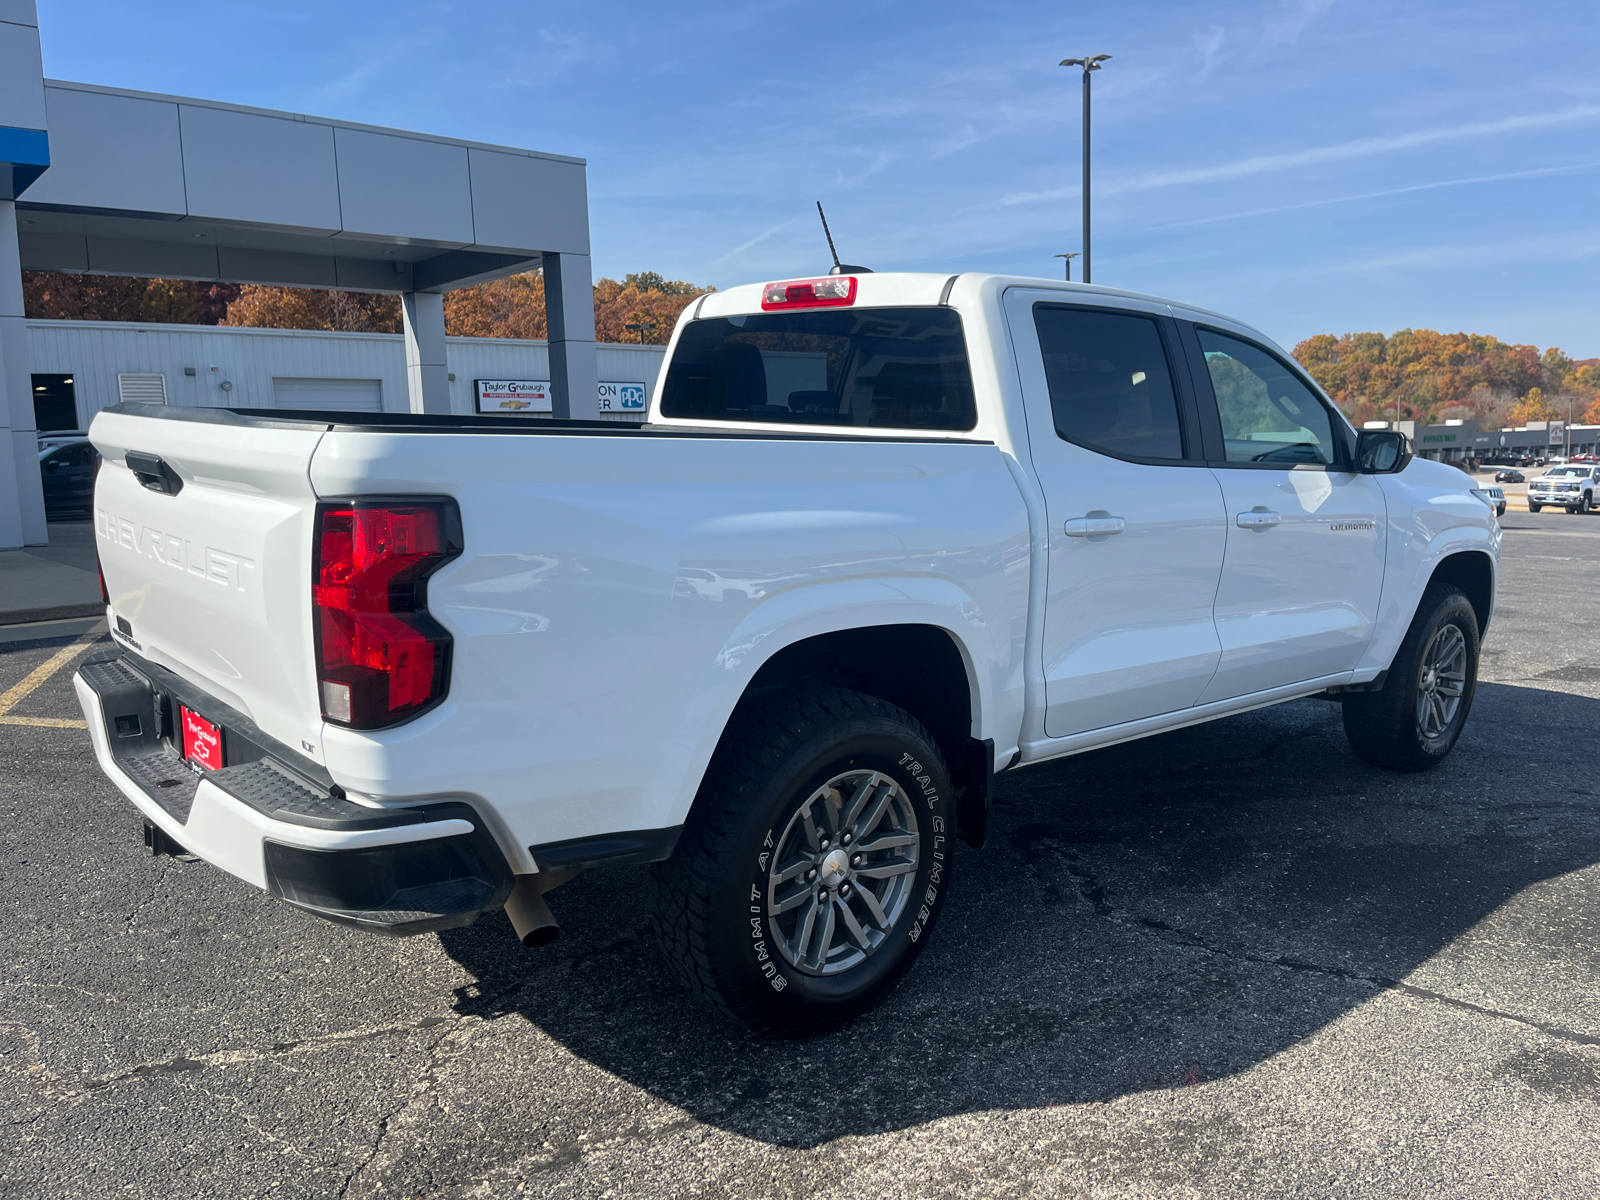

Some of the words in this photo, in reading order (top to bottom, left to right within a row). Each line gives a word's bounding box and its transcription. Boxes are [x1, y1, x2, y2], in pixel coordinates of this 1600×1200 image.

[482, 382, 507, 392] Taylor
[508, 382, 545, 392] Grubaugh
[621, 388, 643, 407] PPG
[96, 507, 255, 592] CHEVROLET
[899, 752, 940, 810] TRAIL
[758, 829, 774, 872] AT
[908, 815, 945, 943] CLIMBER
[750, 883, 788, 992] SUMMIT
